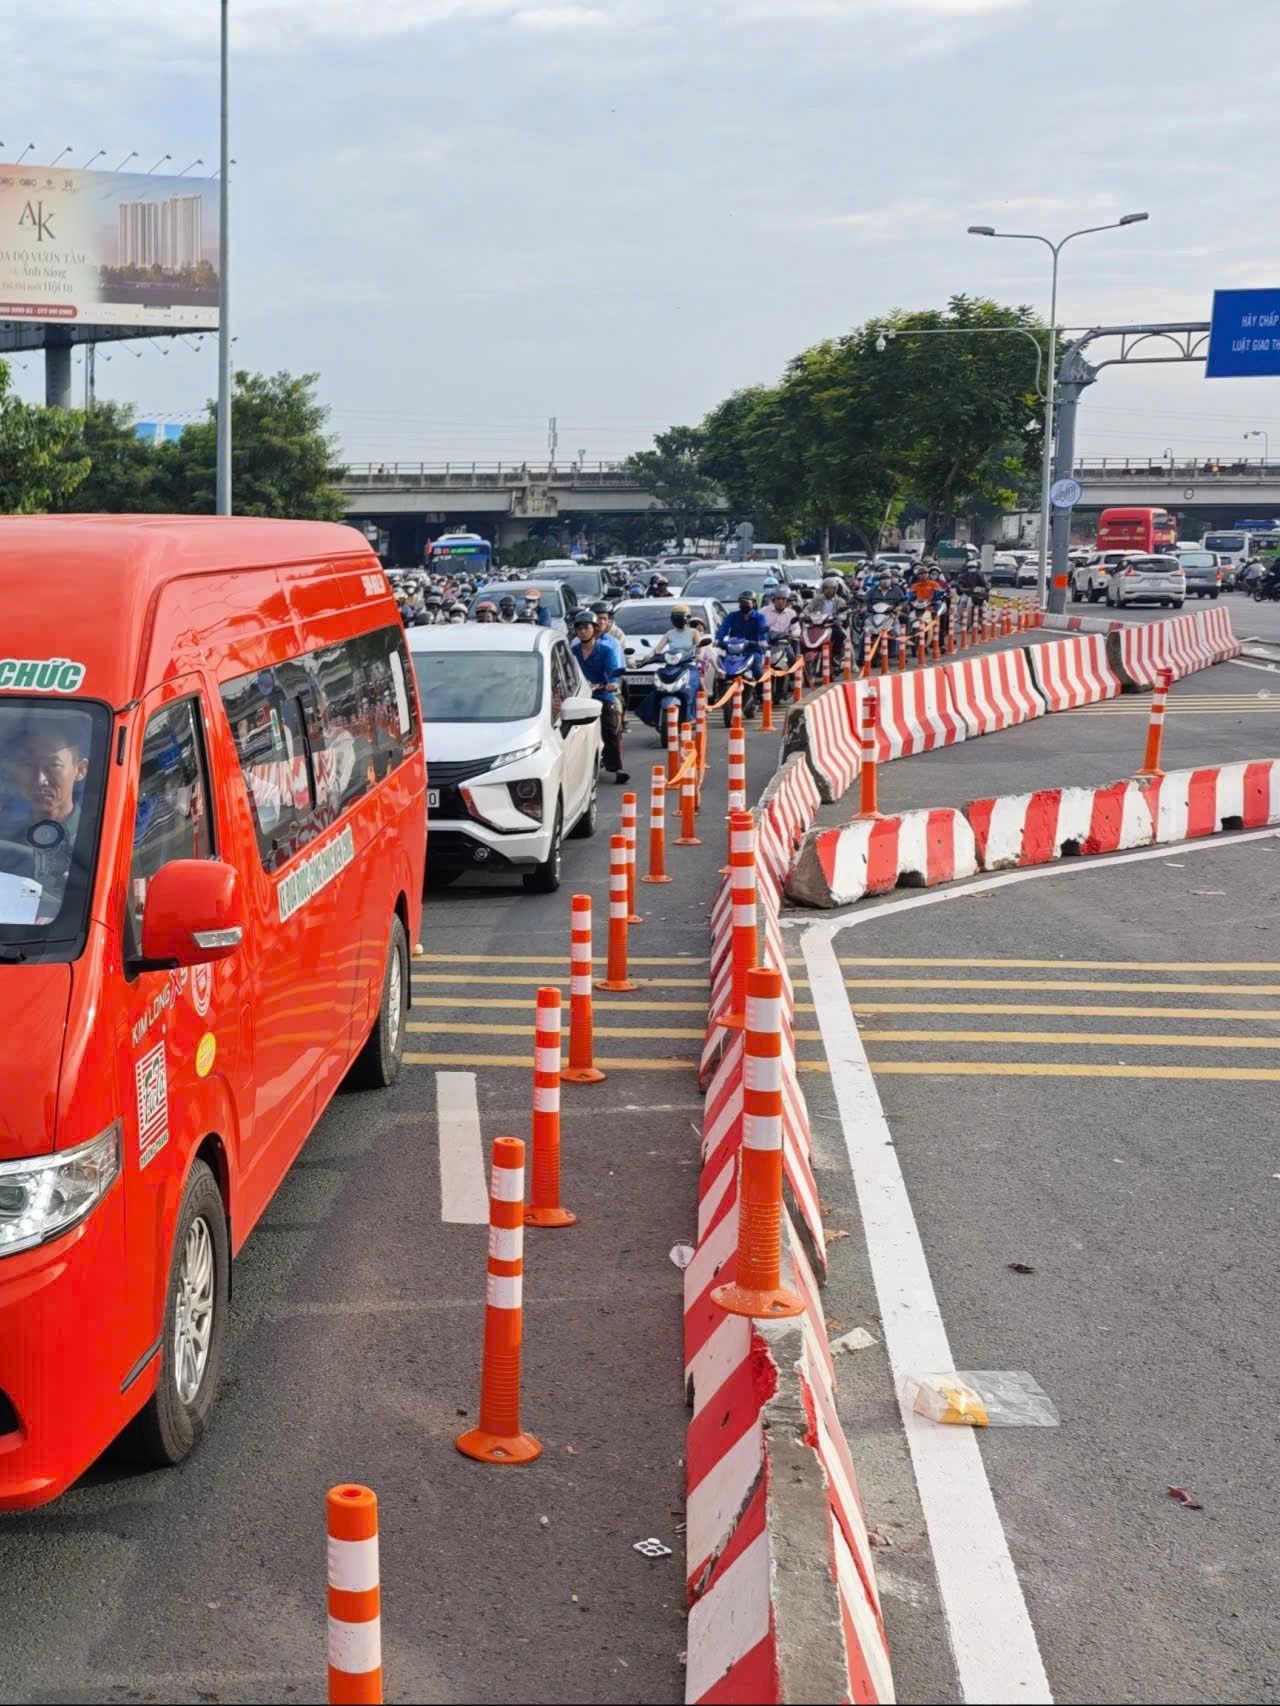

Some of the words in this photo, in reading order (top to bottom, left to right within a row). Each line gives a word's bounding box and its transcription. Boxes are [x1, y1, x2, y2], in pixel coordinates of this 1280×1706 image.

[1241, 313, 1257, 327] HÃY
[1259, 310, 1279, 327] CHẤP
[1232, 337, 1251, 354] LUẬT
[1252, 338, 1270, 351] GIAO
[1055, 483, 1075, 502] 40
[132, 1011, 148, 1048] KIM
[148, 982, 170, 1027] LONG
